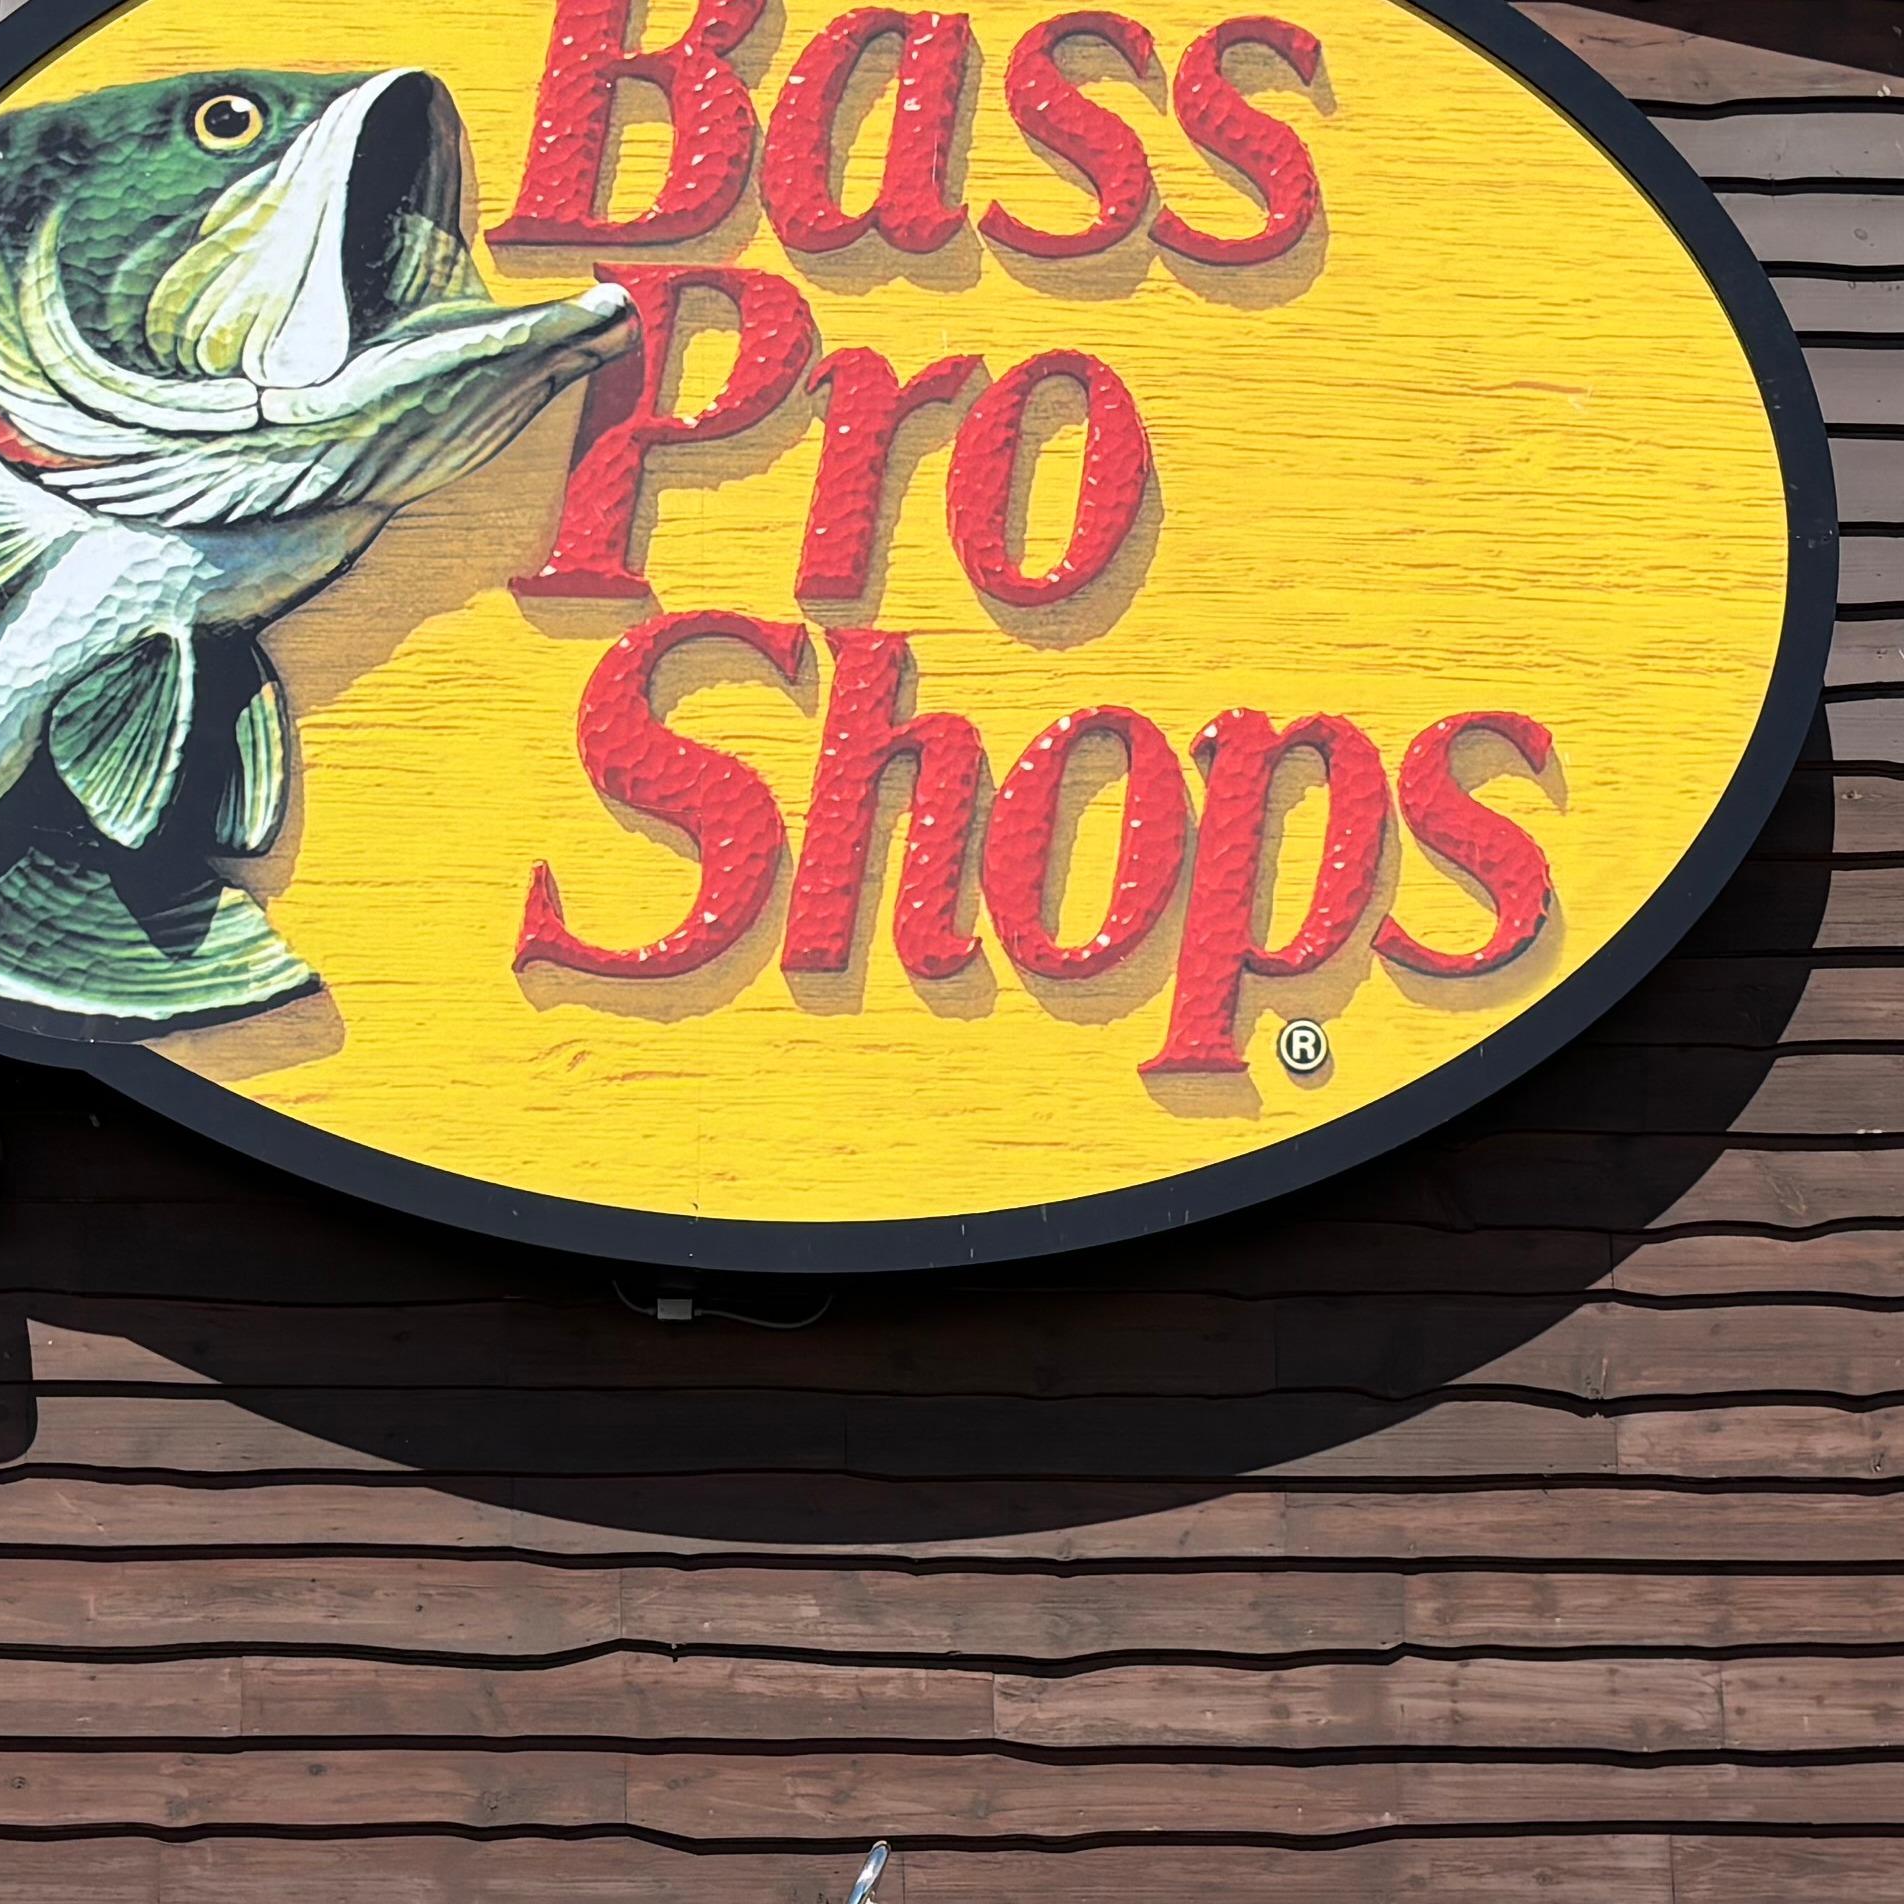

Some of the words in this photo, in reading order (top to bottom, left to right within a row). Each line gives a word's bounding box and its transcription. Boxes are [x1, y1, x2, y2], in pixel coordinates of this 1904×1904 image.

[483, 0, 1322, 266] Bass
[509, 262, 1153, 607] Pro
[512, 610, 1553, 1074] Shops
